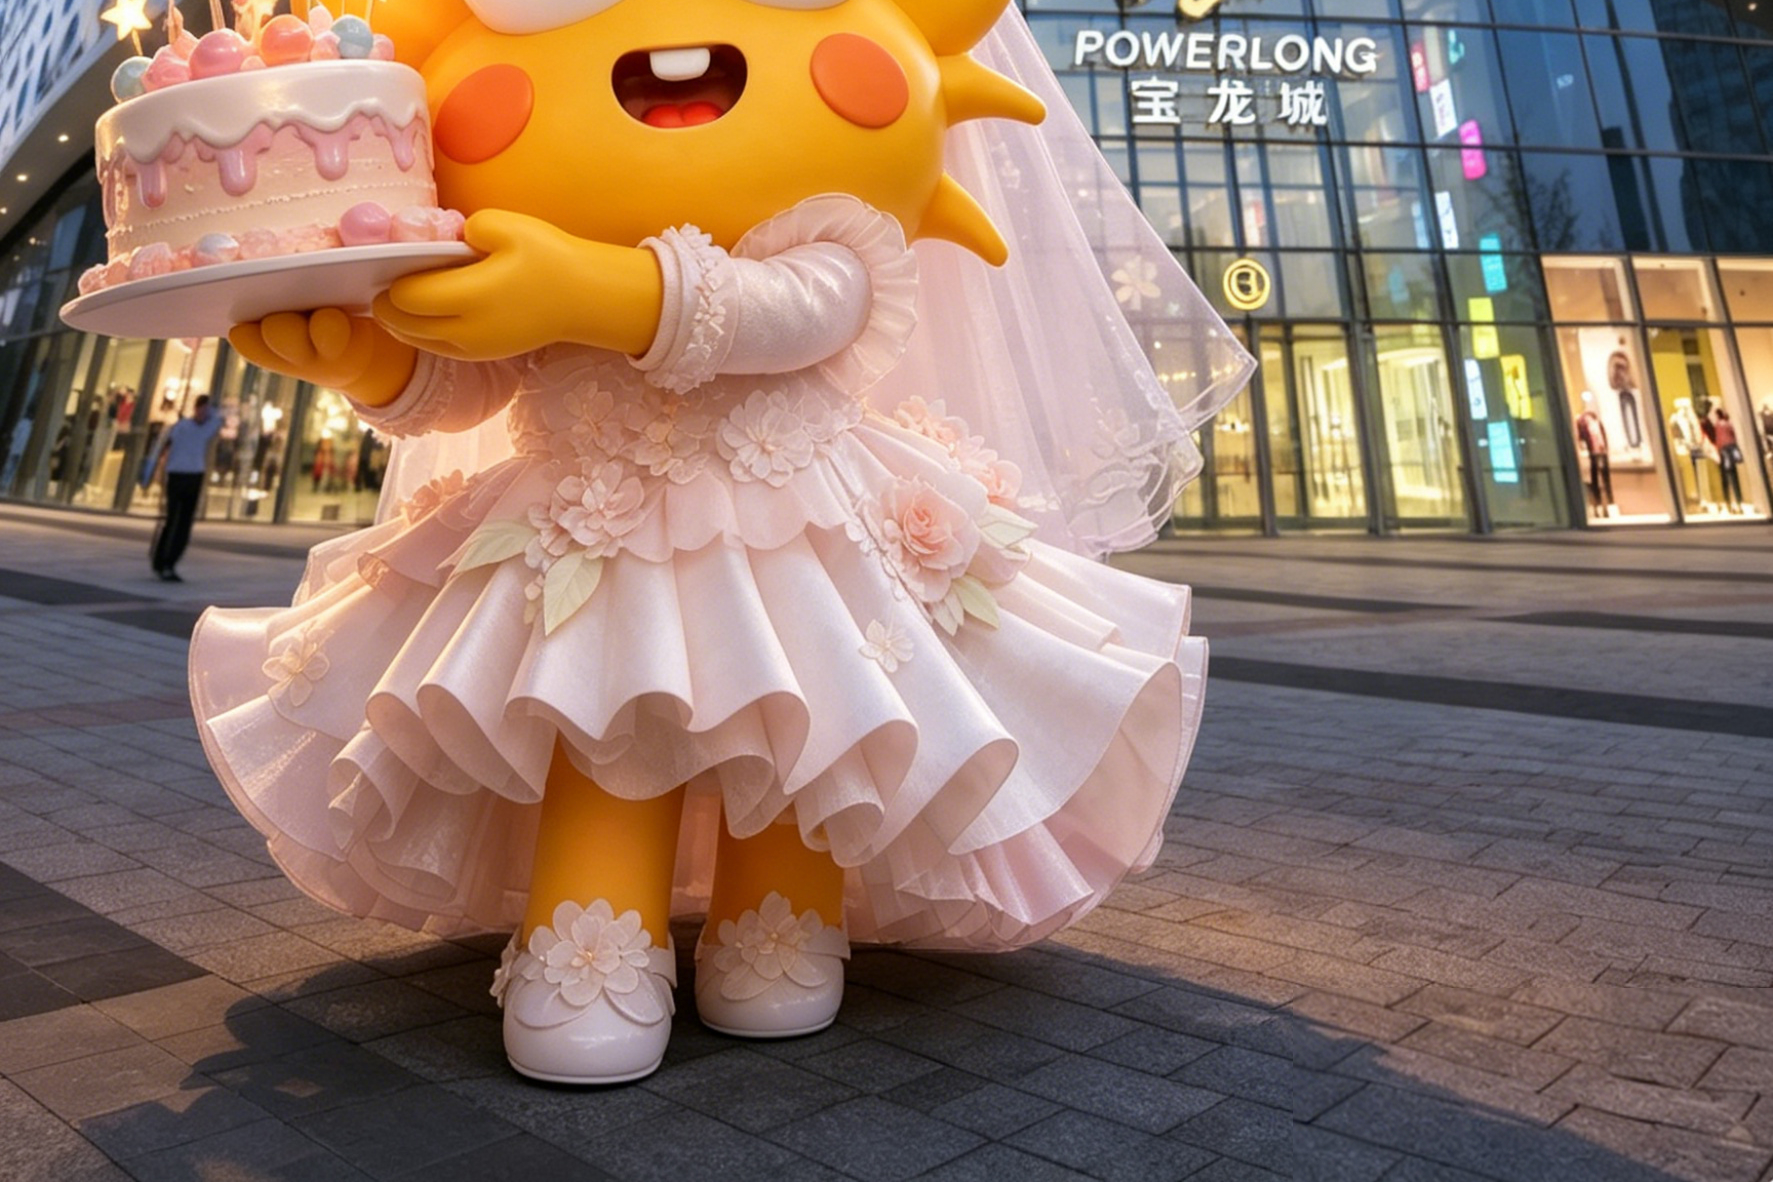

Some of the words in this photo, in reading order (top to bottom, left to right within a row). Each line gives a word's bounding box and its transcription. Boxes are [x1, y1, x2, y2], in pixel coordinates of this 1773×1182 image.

[1074, 30, 1377, 73] POWERLONG
[1130, 76, 1328, 126] 宝龙城
